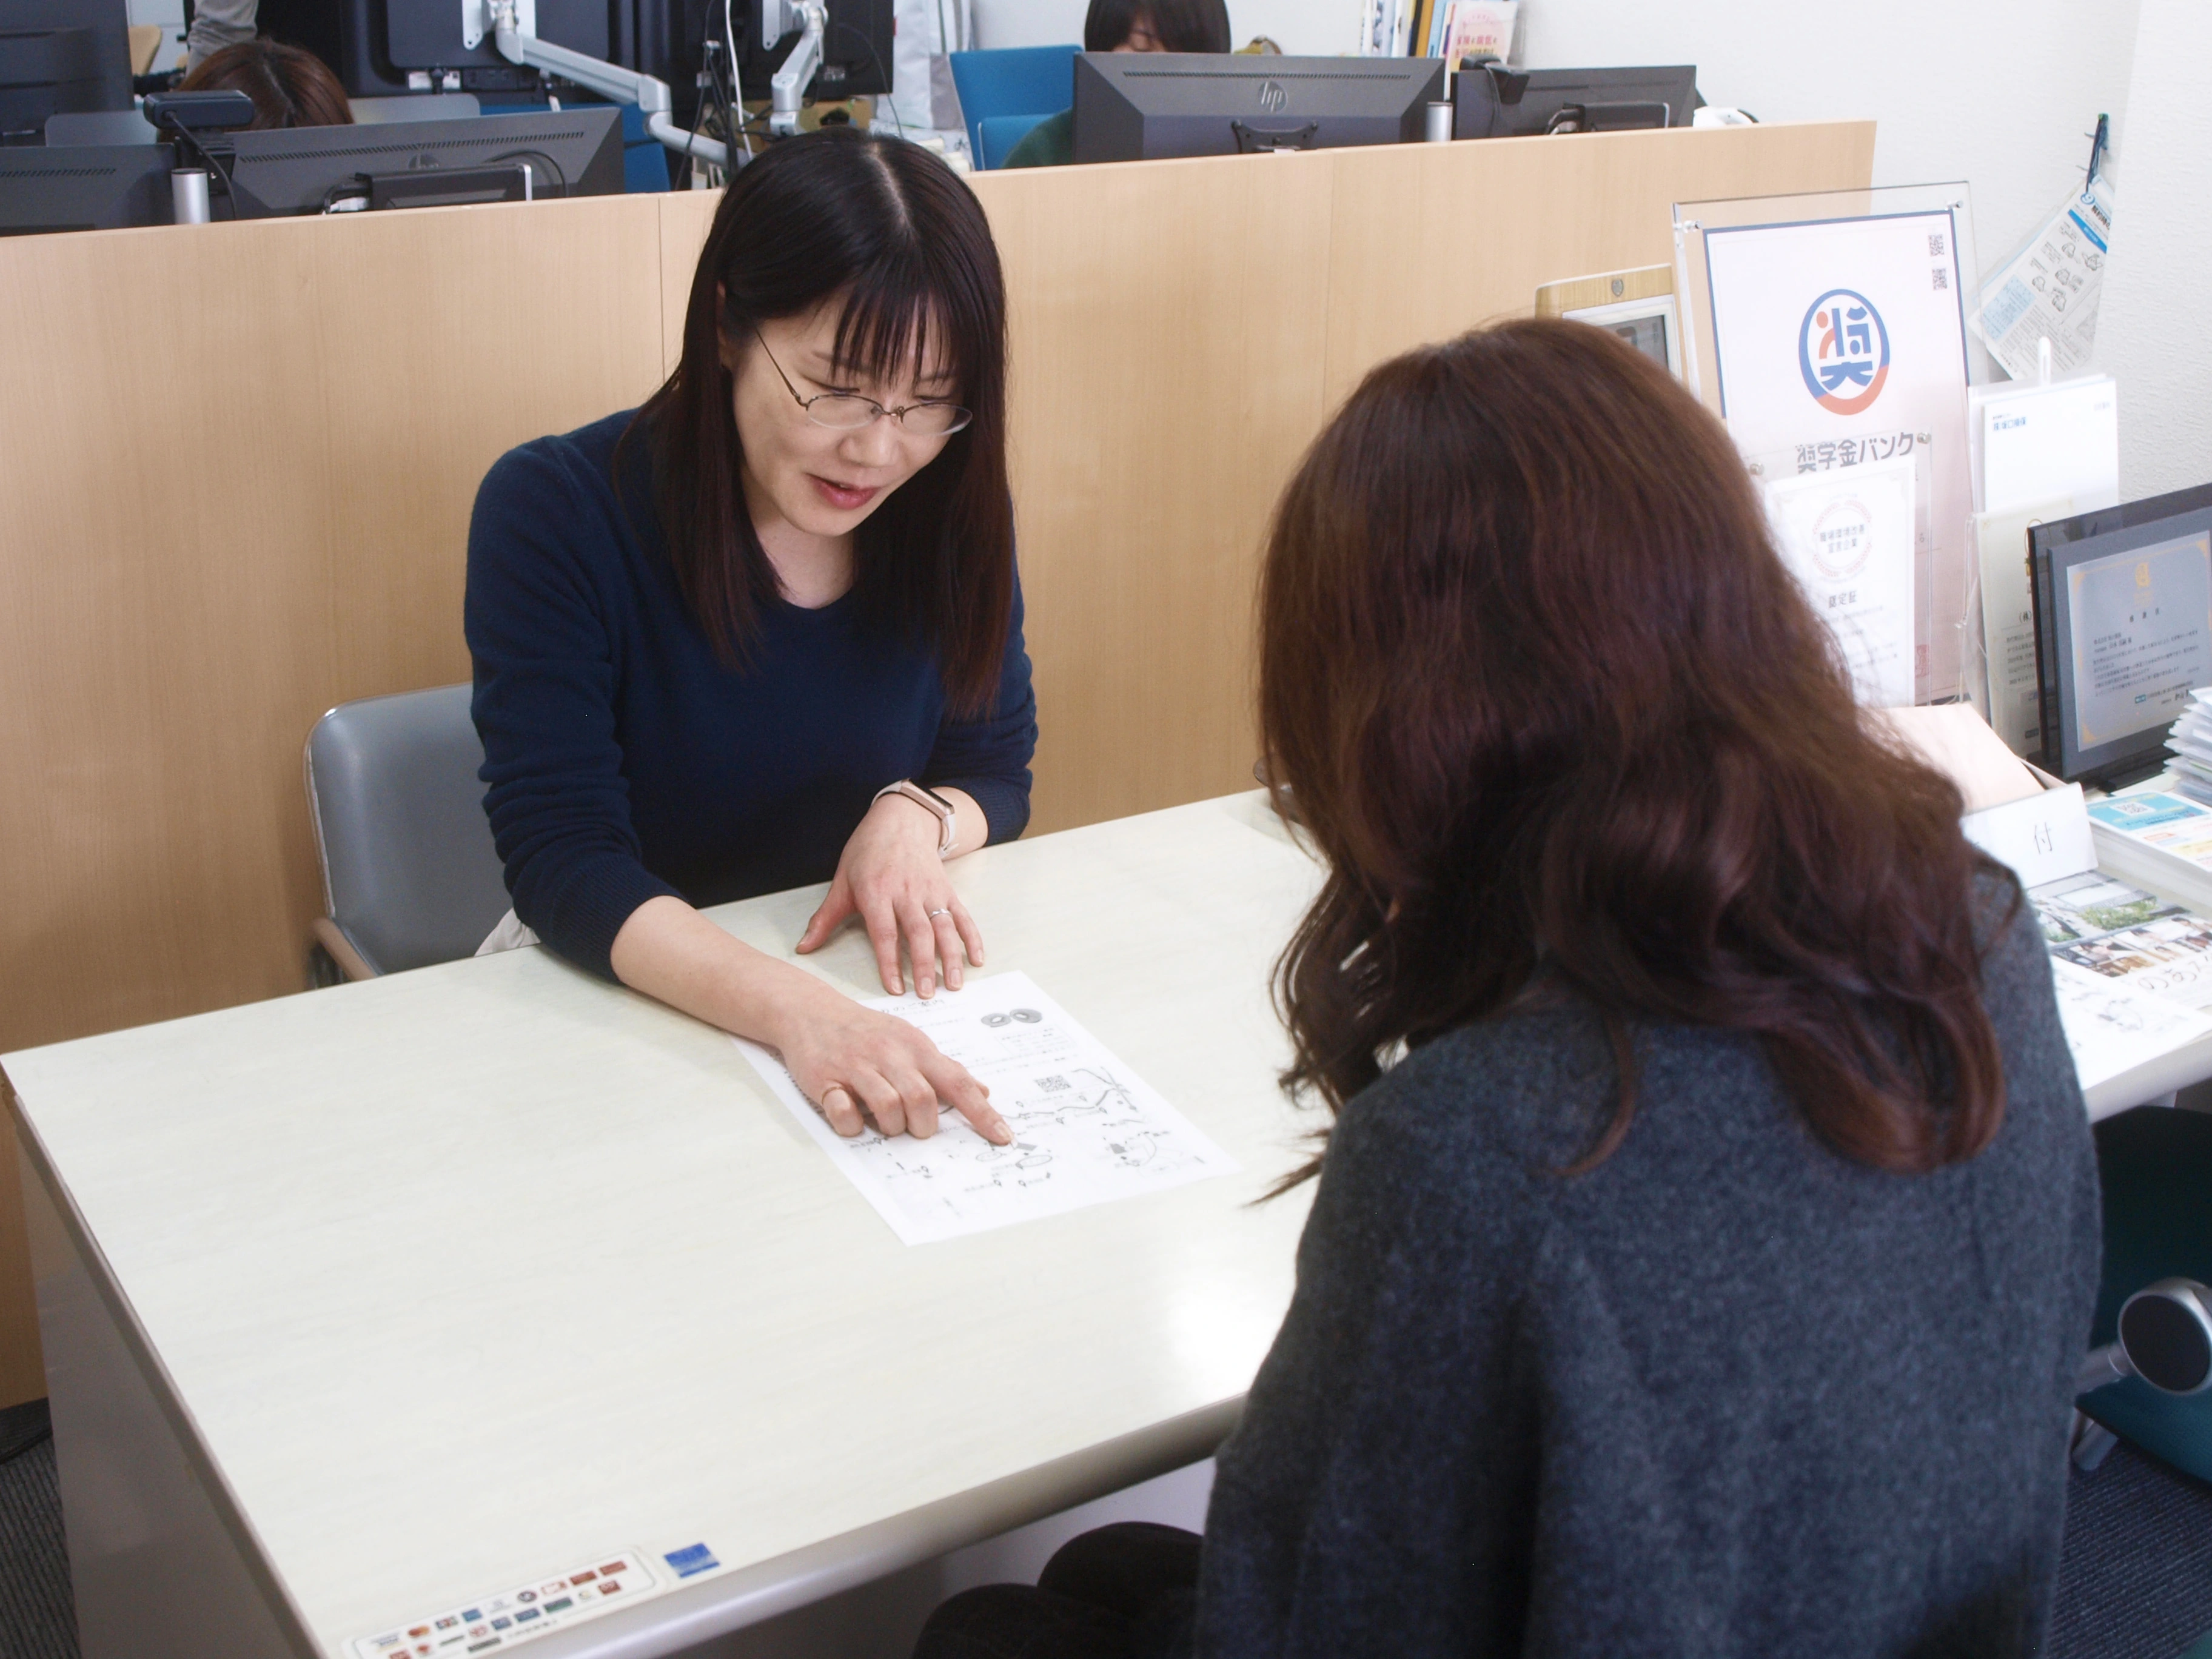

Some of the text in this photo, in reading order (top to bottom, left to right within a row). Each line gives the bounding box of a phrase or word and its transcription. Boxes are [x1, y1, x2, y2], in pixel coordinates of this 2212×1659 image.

[1261, 81, 1282, 113] hp
[1795, 432, 1913, 474] 奨学金バンク
